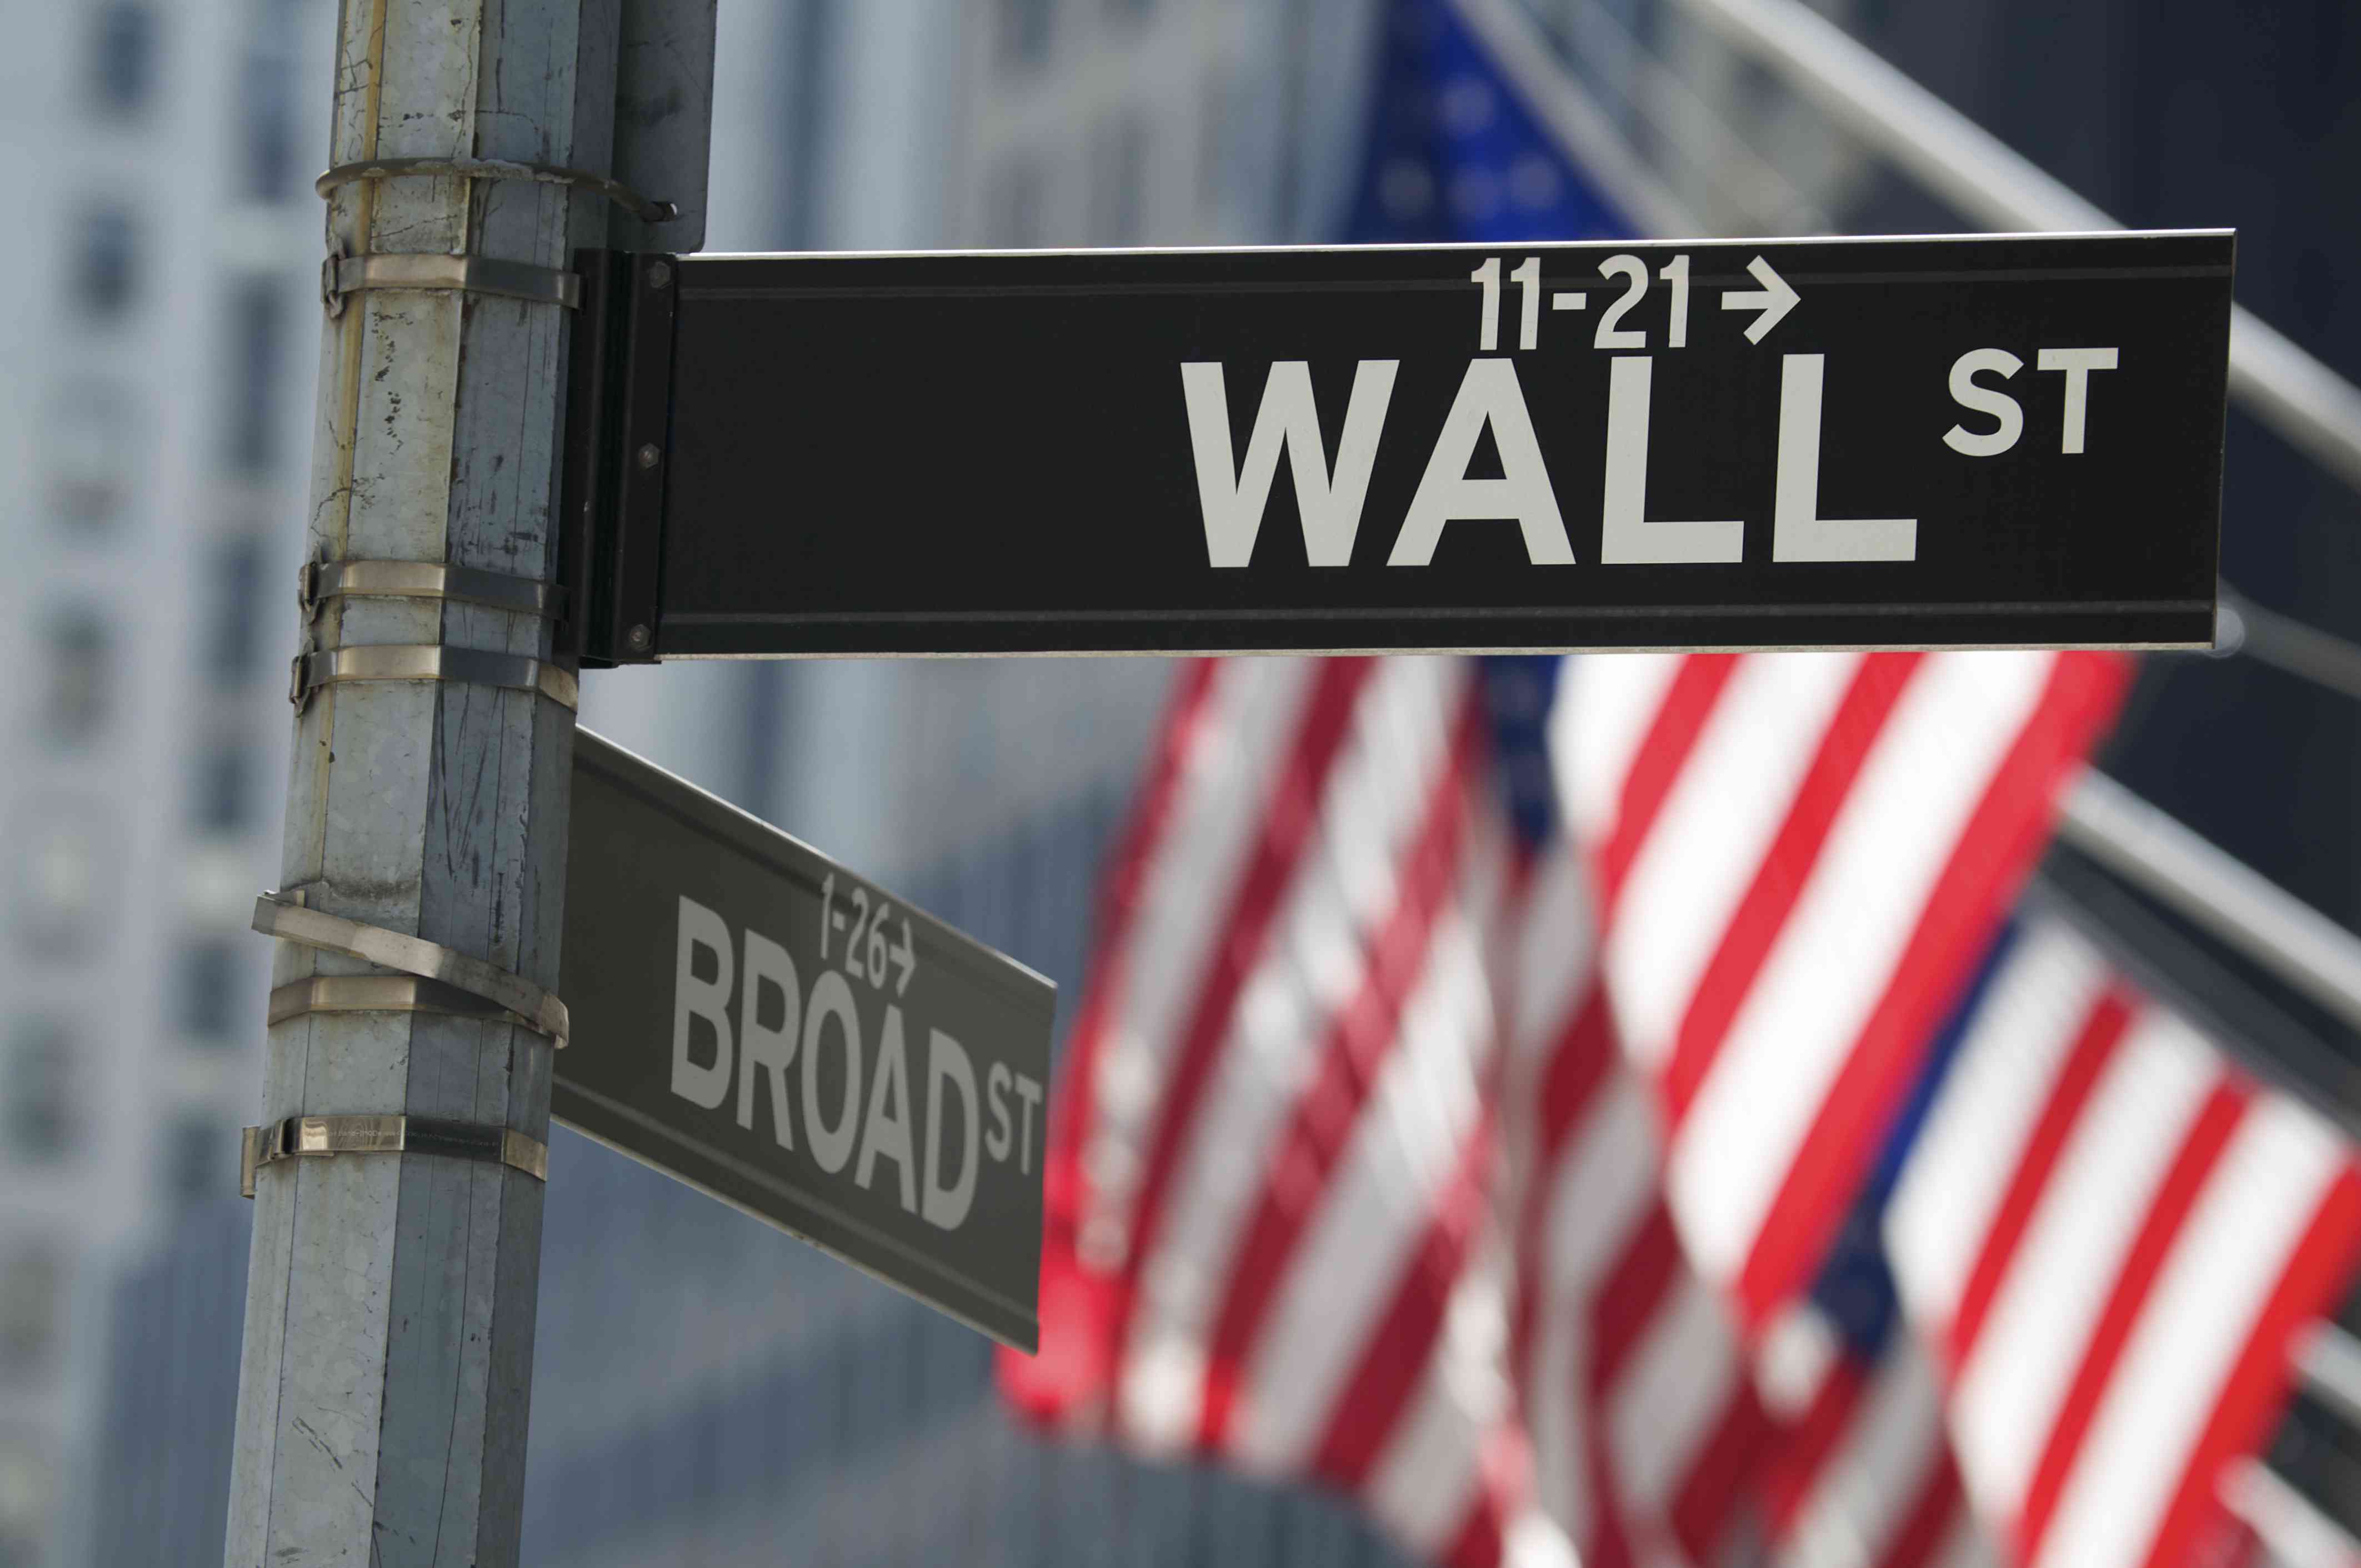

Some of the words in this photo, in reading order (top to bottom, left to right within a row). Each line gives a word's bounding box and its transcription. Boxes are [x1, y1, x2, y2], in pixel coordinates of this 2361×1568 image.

[1470, 254, 1689, 350] 11-21
[1180, 353, 1918, 568] WALL
[1942, 347, 2119, 457] ST
[820, 873, 890, 990] 1-26
[671, 895, 980, 1231] BROAD
[985, 1061, 1043, 1175] ST
